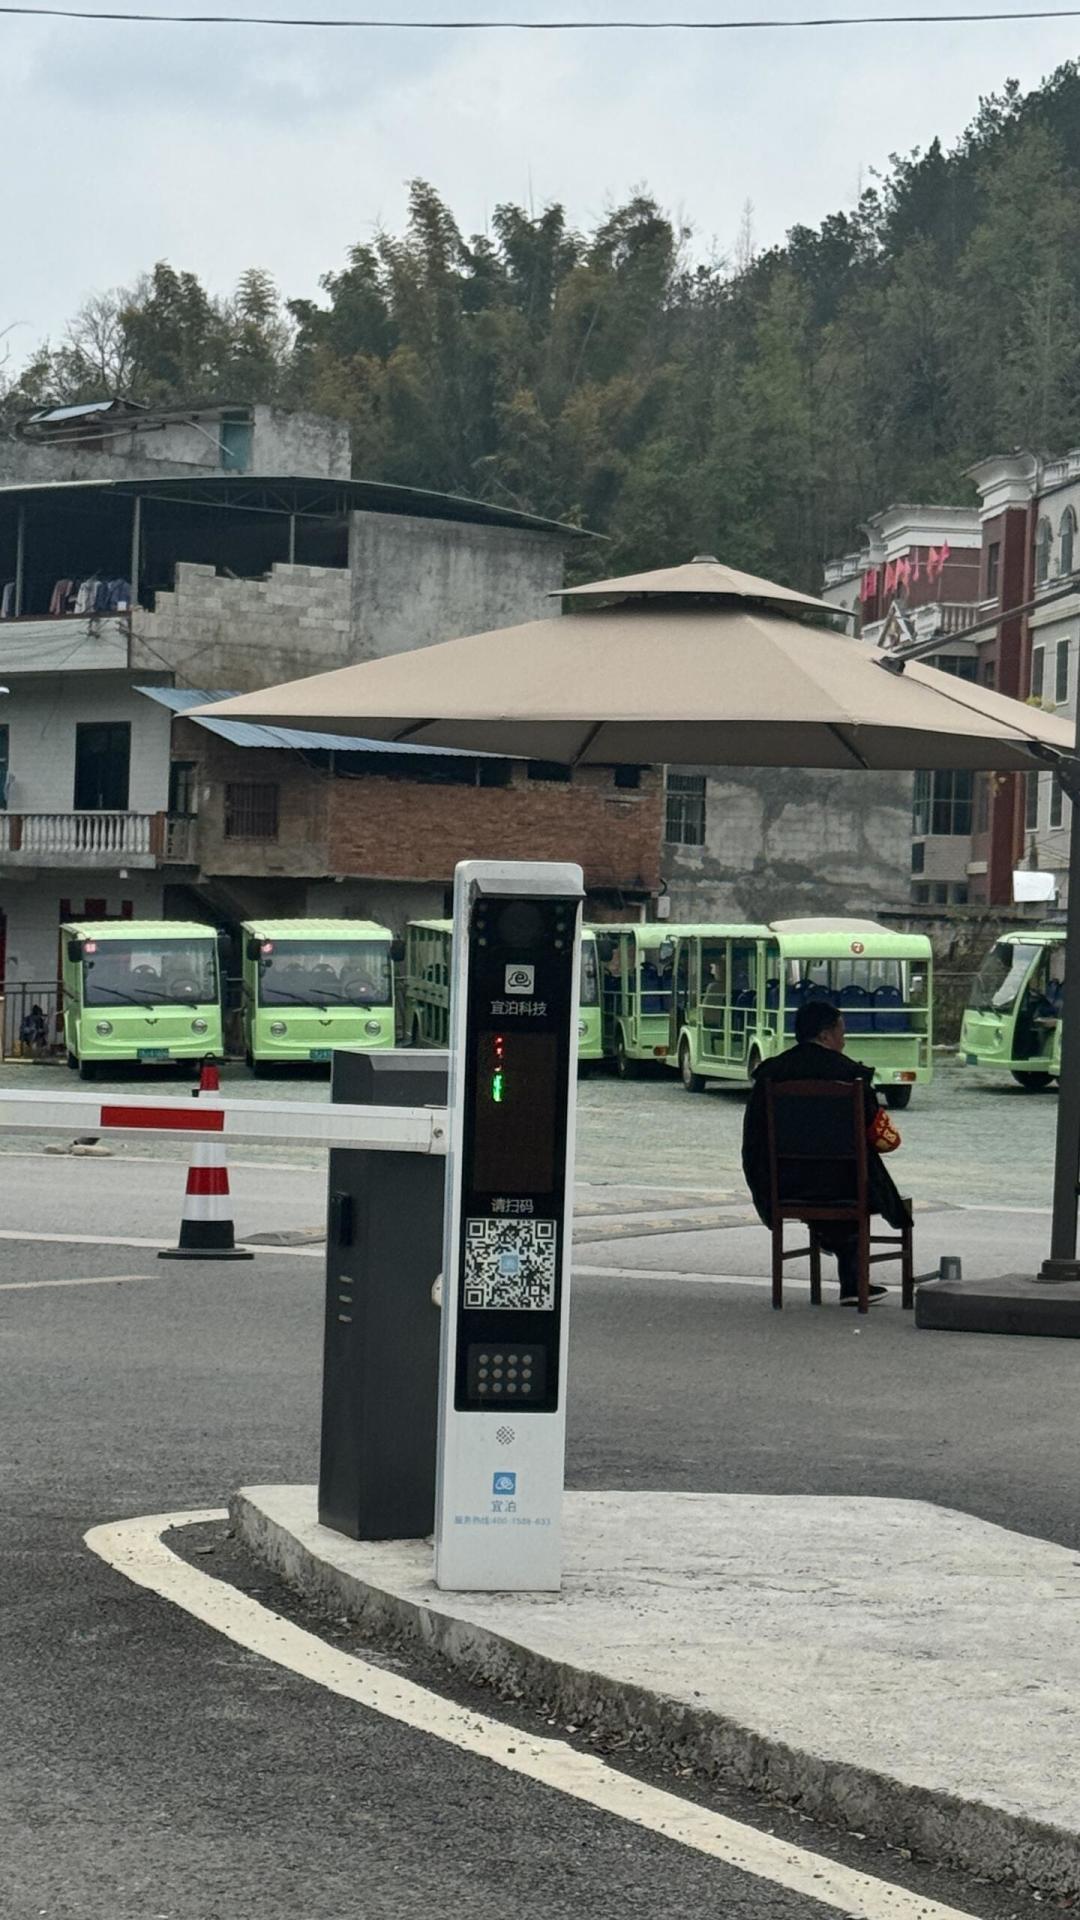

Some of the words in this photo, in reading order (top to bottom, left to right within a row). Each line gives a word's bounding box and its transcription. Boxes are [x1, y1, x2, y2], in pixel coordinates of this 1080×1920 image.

[490, 1000, 548, 1016] 宜泊科技
[491, 1198, 534, 1213] 请扫码
[491, 1500, 517, 1513] 宜泊
